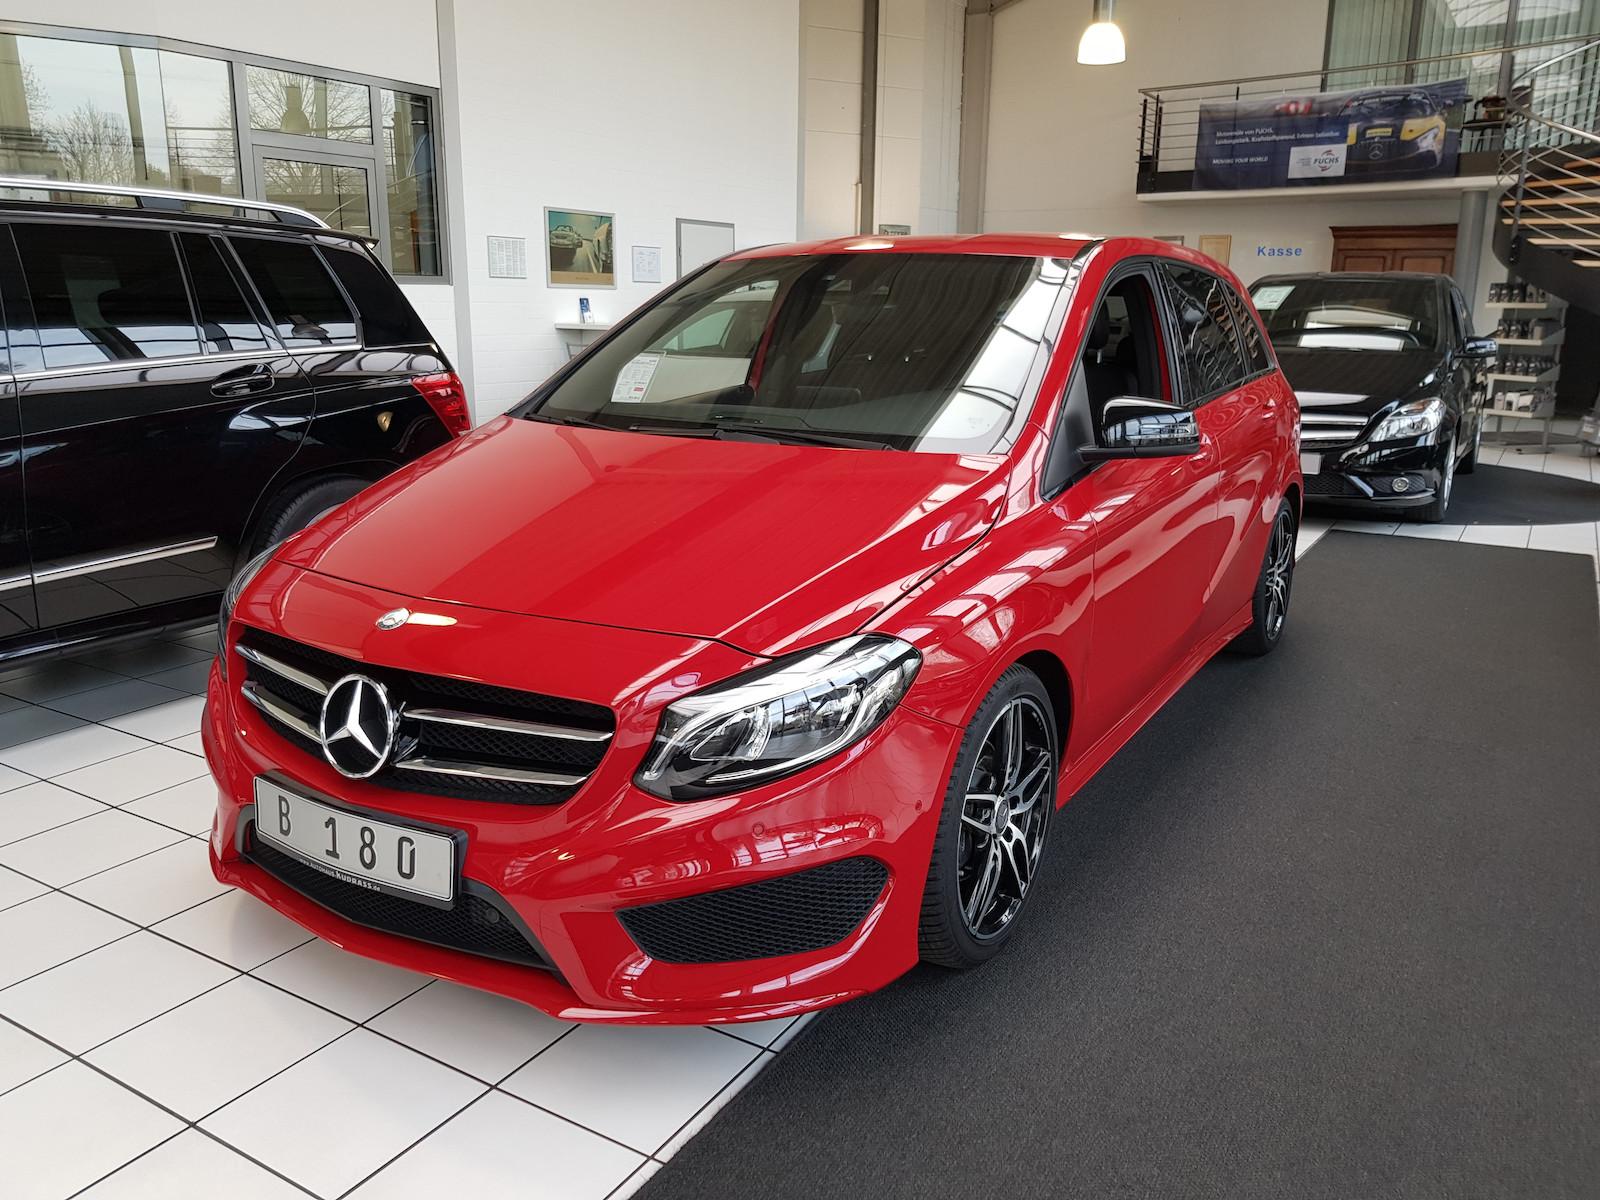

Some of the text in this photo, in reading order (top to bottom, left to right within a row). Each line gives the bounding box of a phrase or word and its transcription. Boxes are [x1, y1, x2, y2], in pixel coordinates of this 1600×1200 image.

[1313, 156, 1340, 165] FUCHS
[1257, 245, 1303, 257] Kasse
[278, 795, 416, 881] B 180
